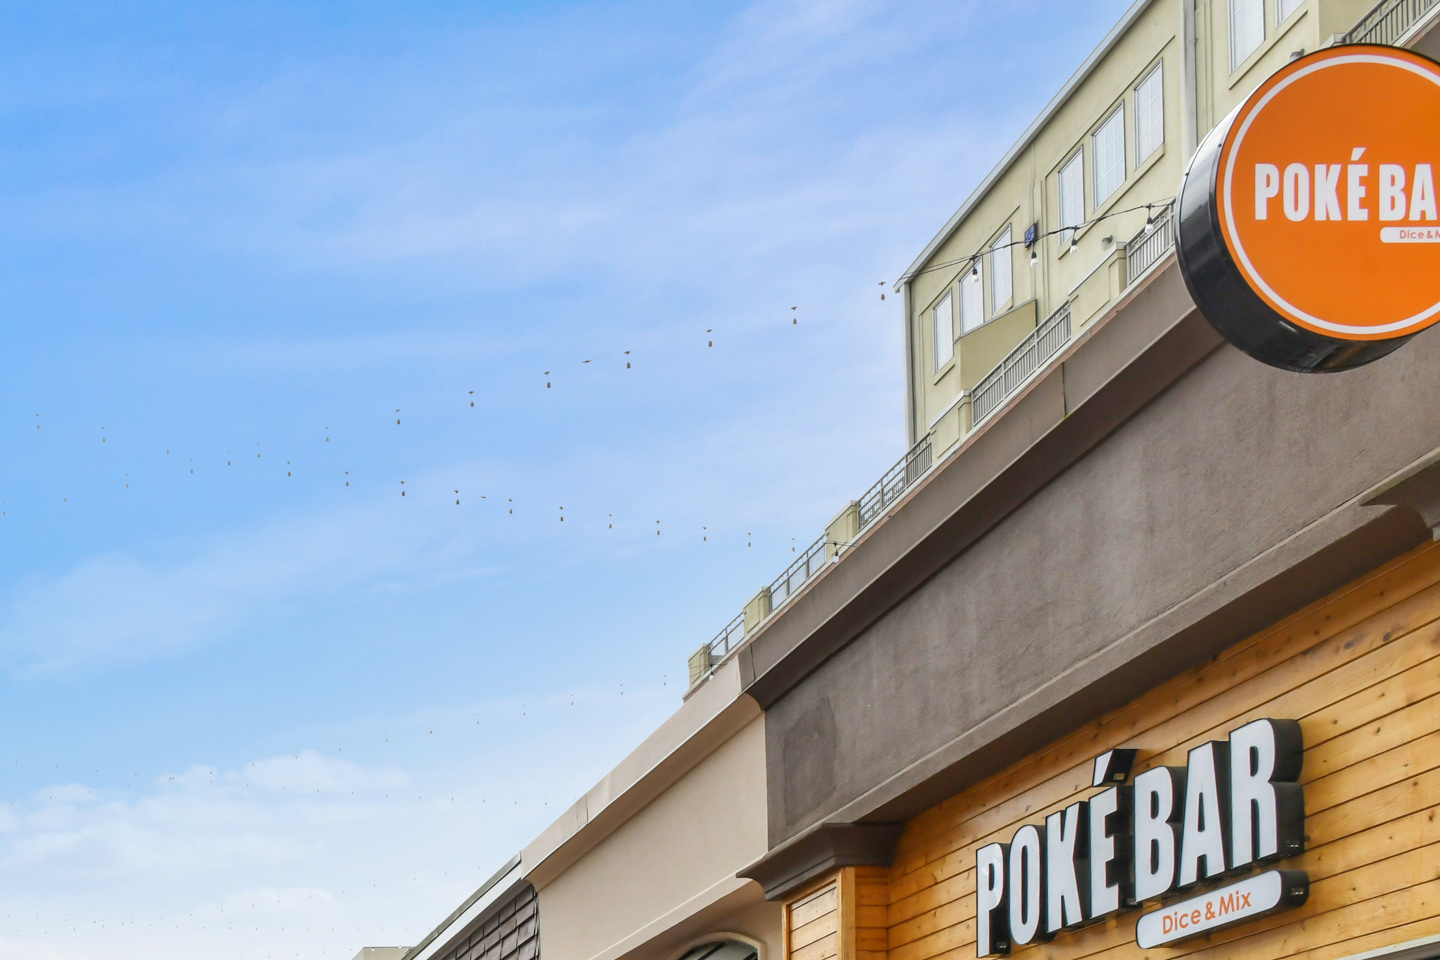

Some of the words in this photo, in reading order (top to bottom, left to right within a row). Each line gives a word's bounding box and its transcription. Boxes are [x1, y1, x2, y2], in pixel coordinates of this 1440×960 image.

[1254, 147, 1369, 222] POKÉ
[976, 749, 1128, 958] POKÉ
[1133, 718, 1295, 903] BAR
